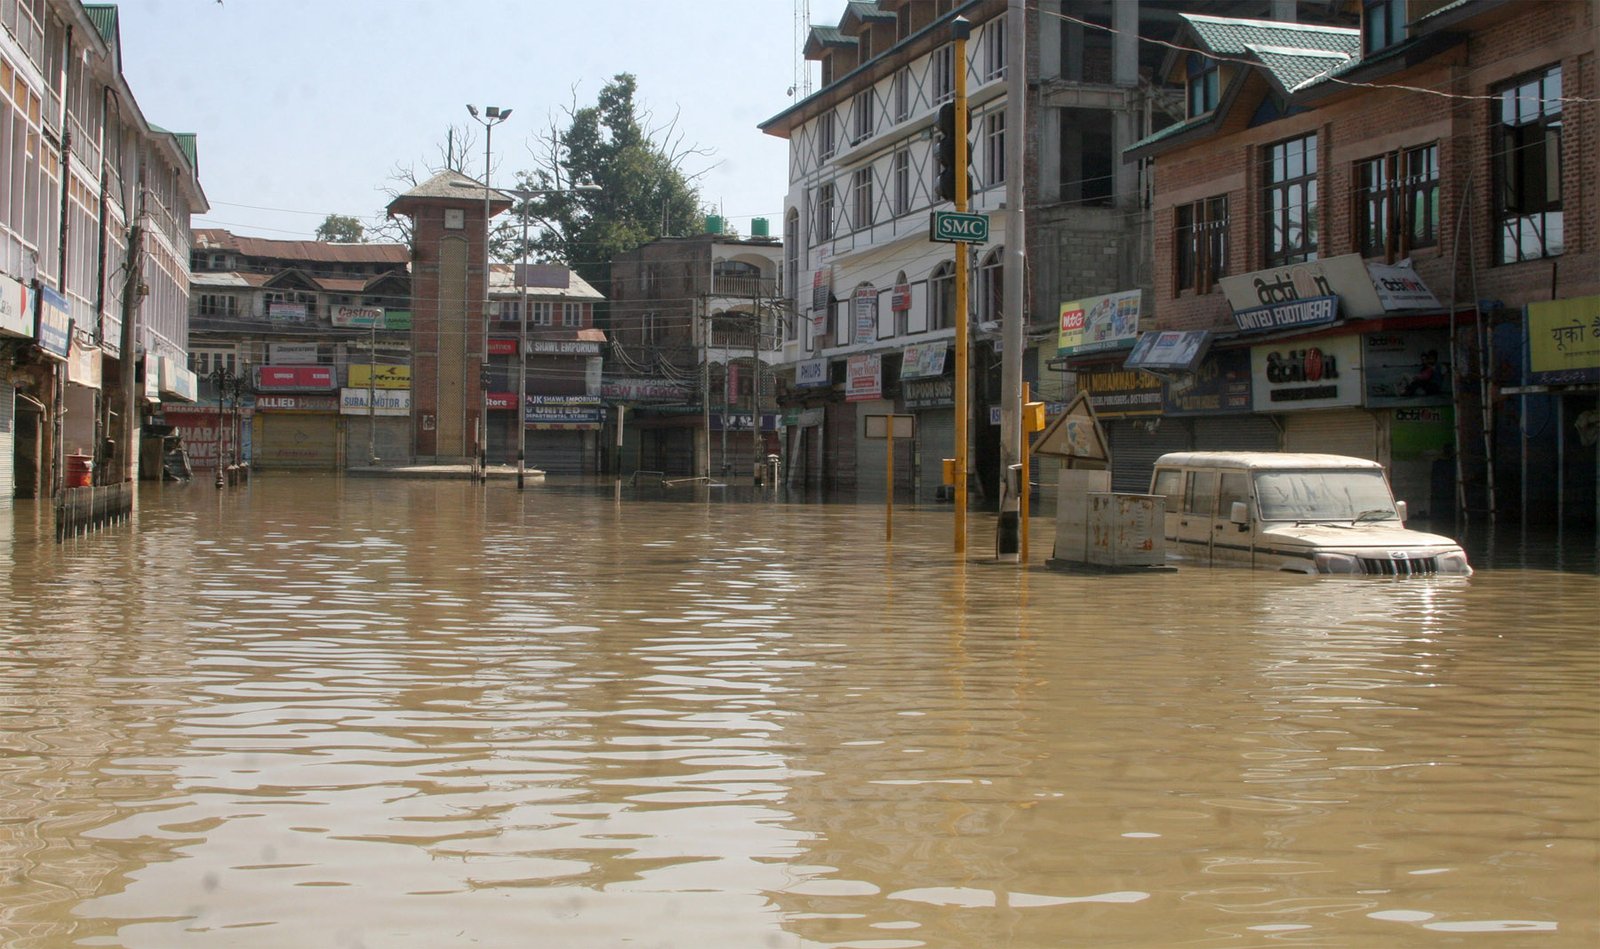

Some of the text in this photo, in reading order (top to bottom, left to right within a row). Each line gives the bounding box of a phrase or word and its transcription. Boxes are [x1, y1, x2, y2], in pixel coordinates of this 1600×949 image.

[942, 218, 983, 235] SMC
[1236, 299, 1333, 330] UNITED FOOTWEAR
[1551, 319, 1586, 351] यूको
[535, 342, 559, 353] SHAWL
[562, 341, 600, 353] EMPORIUM
[801, 362, 821, 378] PHILIPS
[934, 380, 952, 397] SONS
[257, 398, 295, 408] ALLIED
[344, 397, 369, 407] SURAJ
[372, 398, 400, 408] MOTOR
[536, 406, 580, 414] UNITED
[180, 427, 232, 441] HARAT
